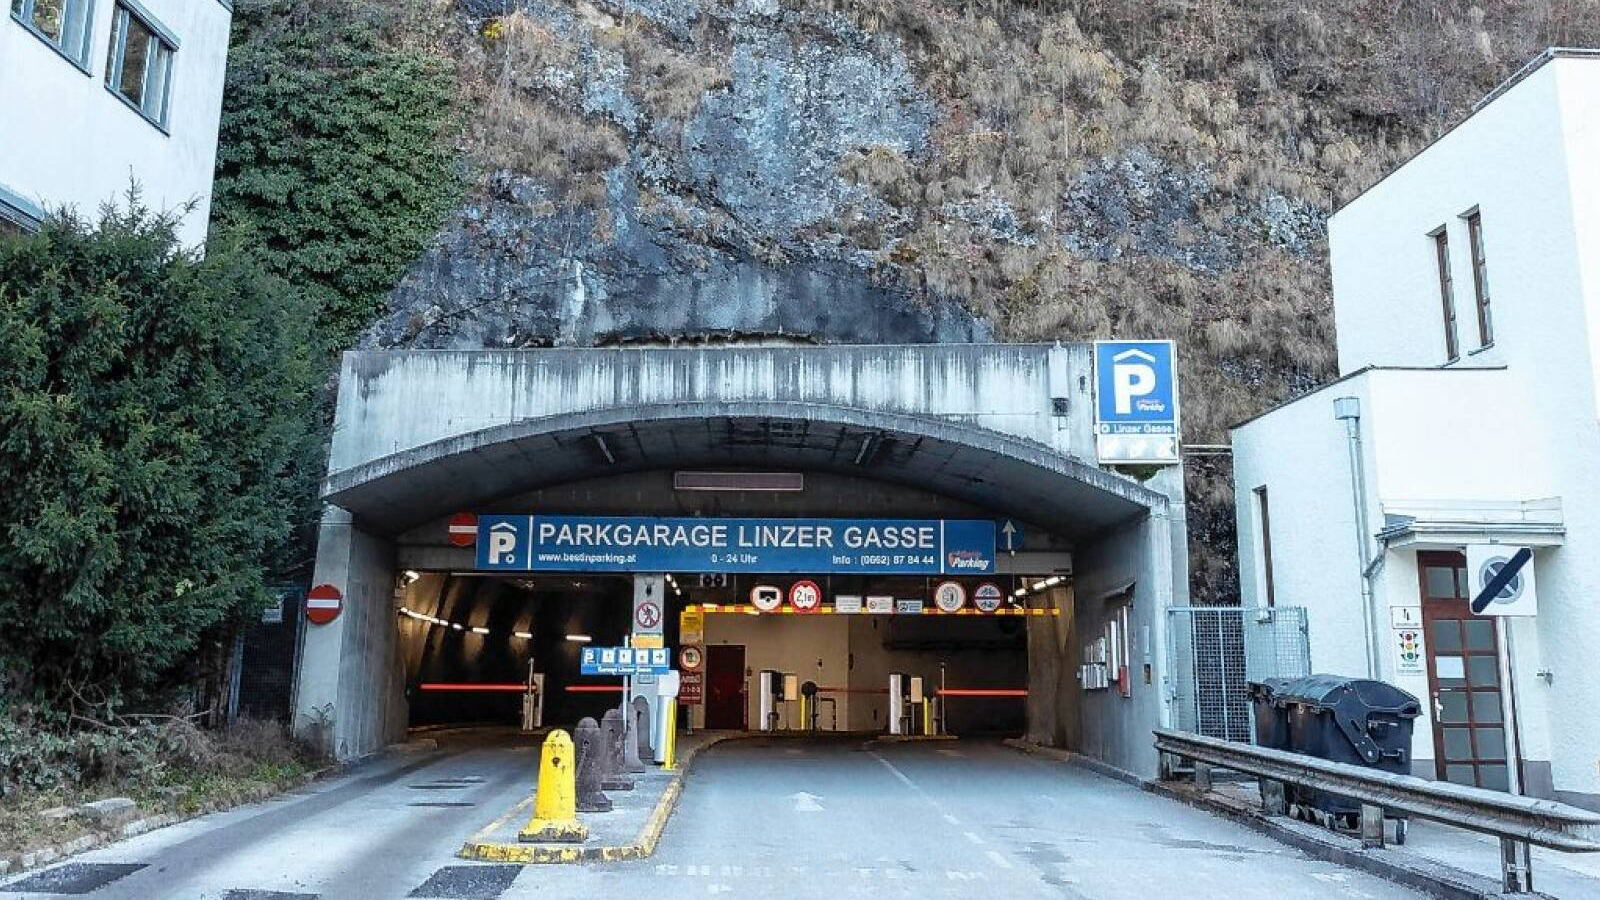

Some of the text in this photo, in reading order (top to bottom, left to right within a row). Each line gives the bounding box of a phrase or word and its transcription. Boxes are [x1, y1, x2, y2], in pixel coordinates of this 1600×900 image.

[1114, 364, 1156, 414] P
[539, 523, 934, 549] PARKGARAGE LINZER GASSE
[488, 532, 516, 565] P
[538, 552, 637, 565] www.bestinparking.at
[726, 553, 738, 563] 24
[740, 553, 758, 563] Uhr
[832, 554, 851, 565] Info
[893, 555, 906, 565] 87
[907, 555, 920, 565] 84
[921, 555, 934, 565] 44
[951, 557, 990, 571] Parking
